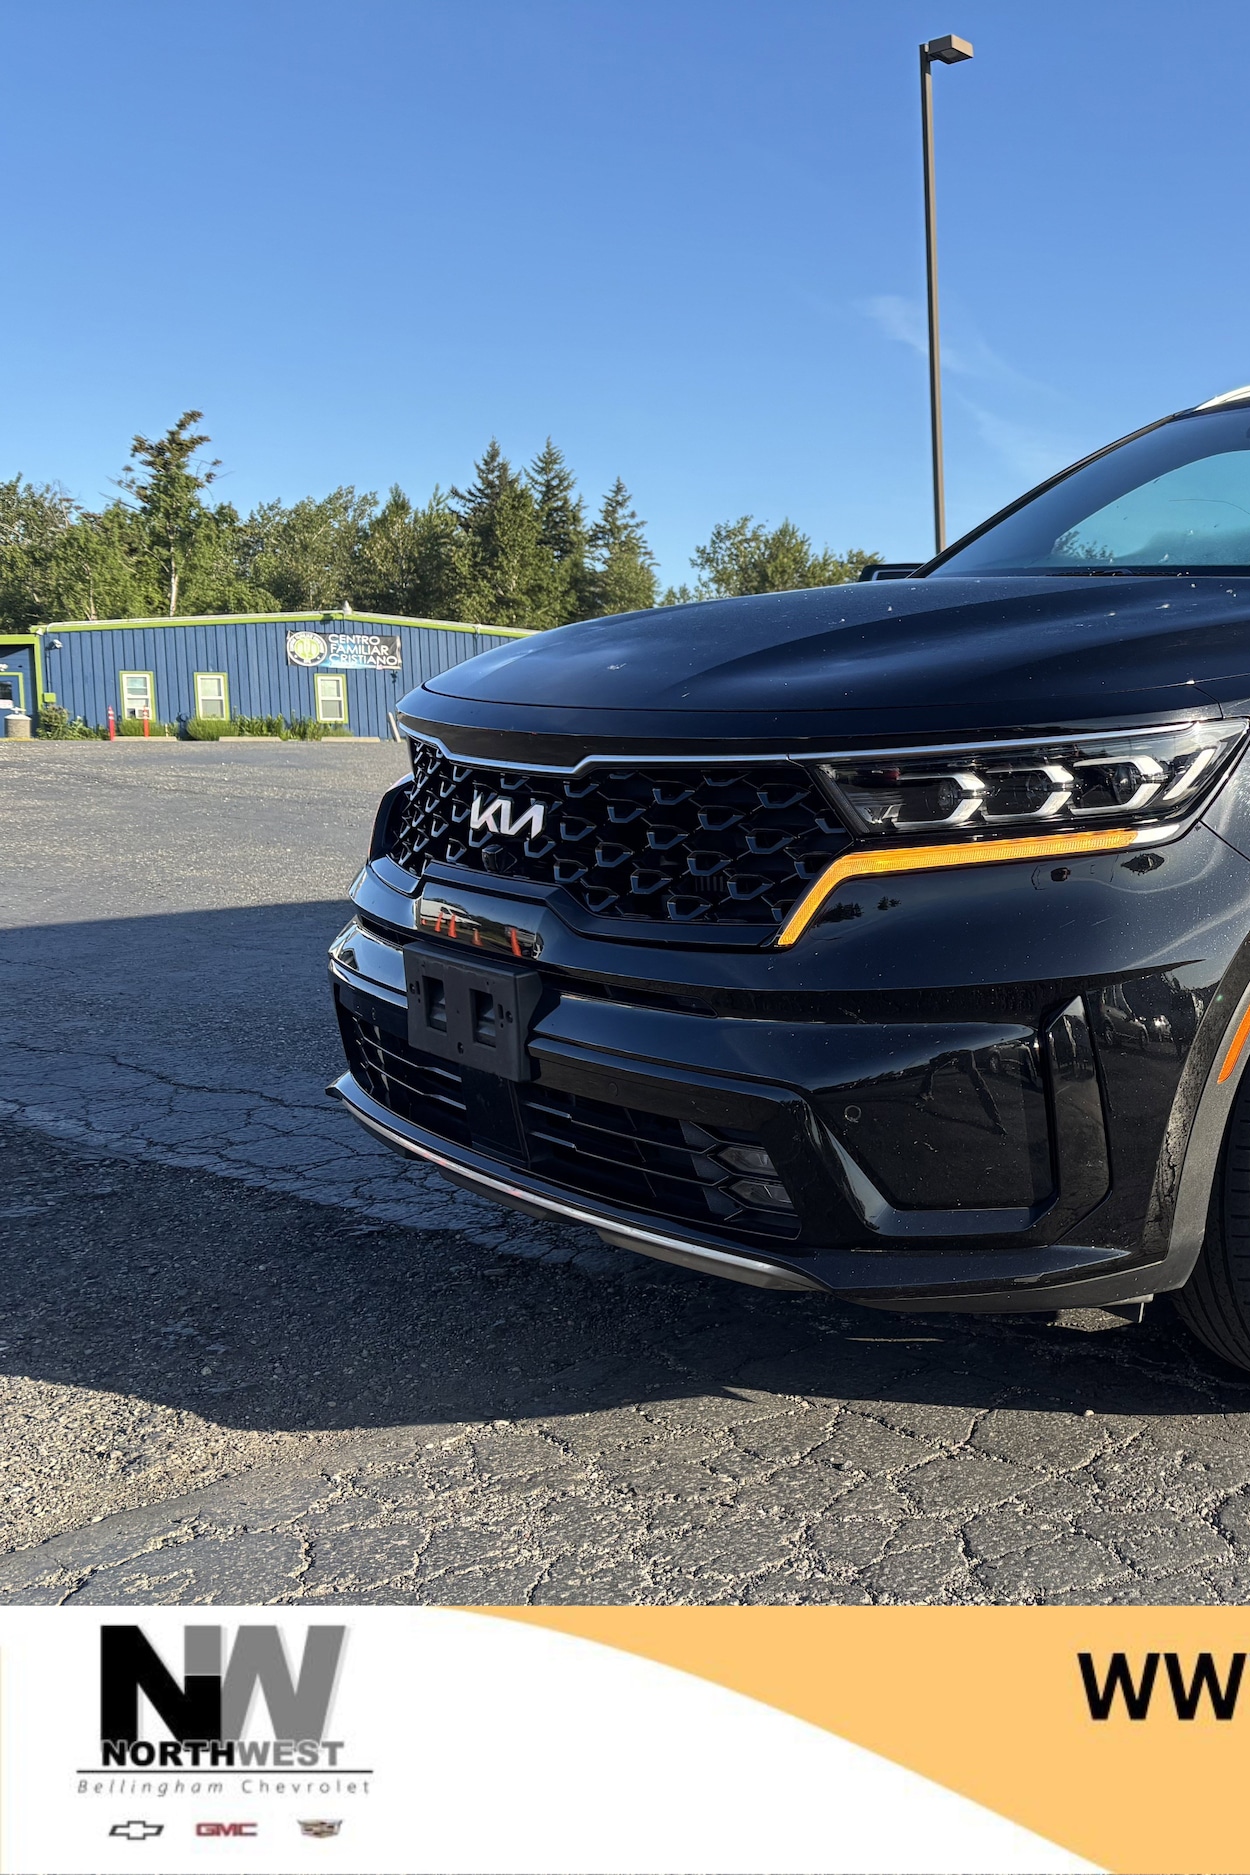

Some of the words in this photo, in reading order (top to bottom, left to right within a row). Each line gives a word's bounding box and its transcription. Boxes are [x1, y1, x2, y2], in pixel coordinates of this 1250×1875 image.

[328, 633, 381, 646] CENTRO
[330, 643, 389, 656] FAMILIAR
[328, 653, 398, 665] CRISTIANO
[470, 793, 545, 839] KIA
